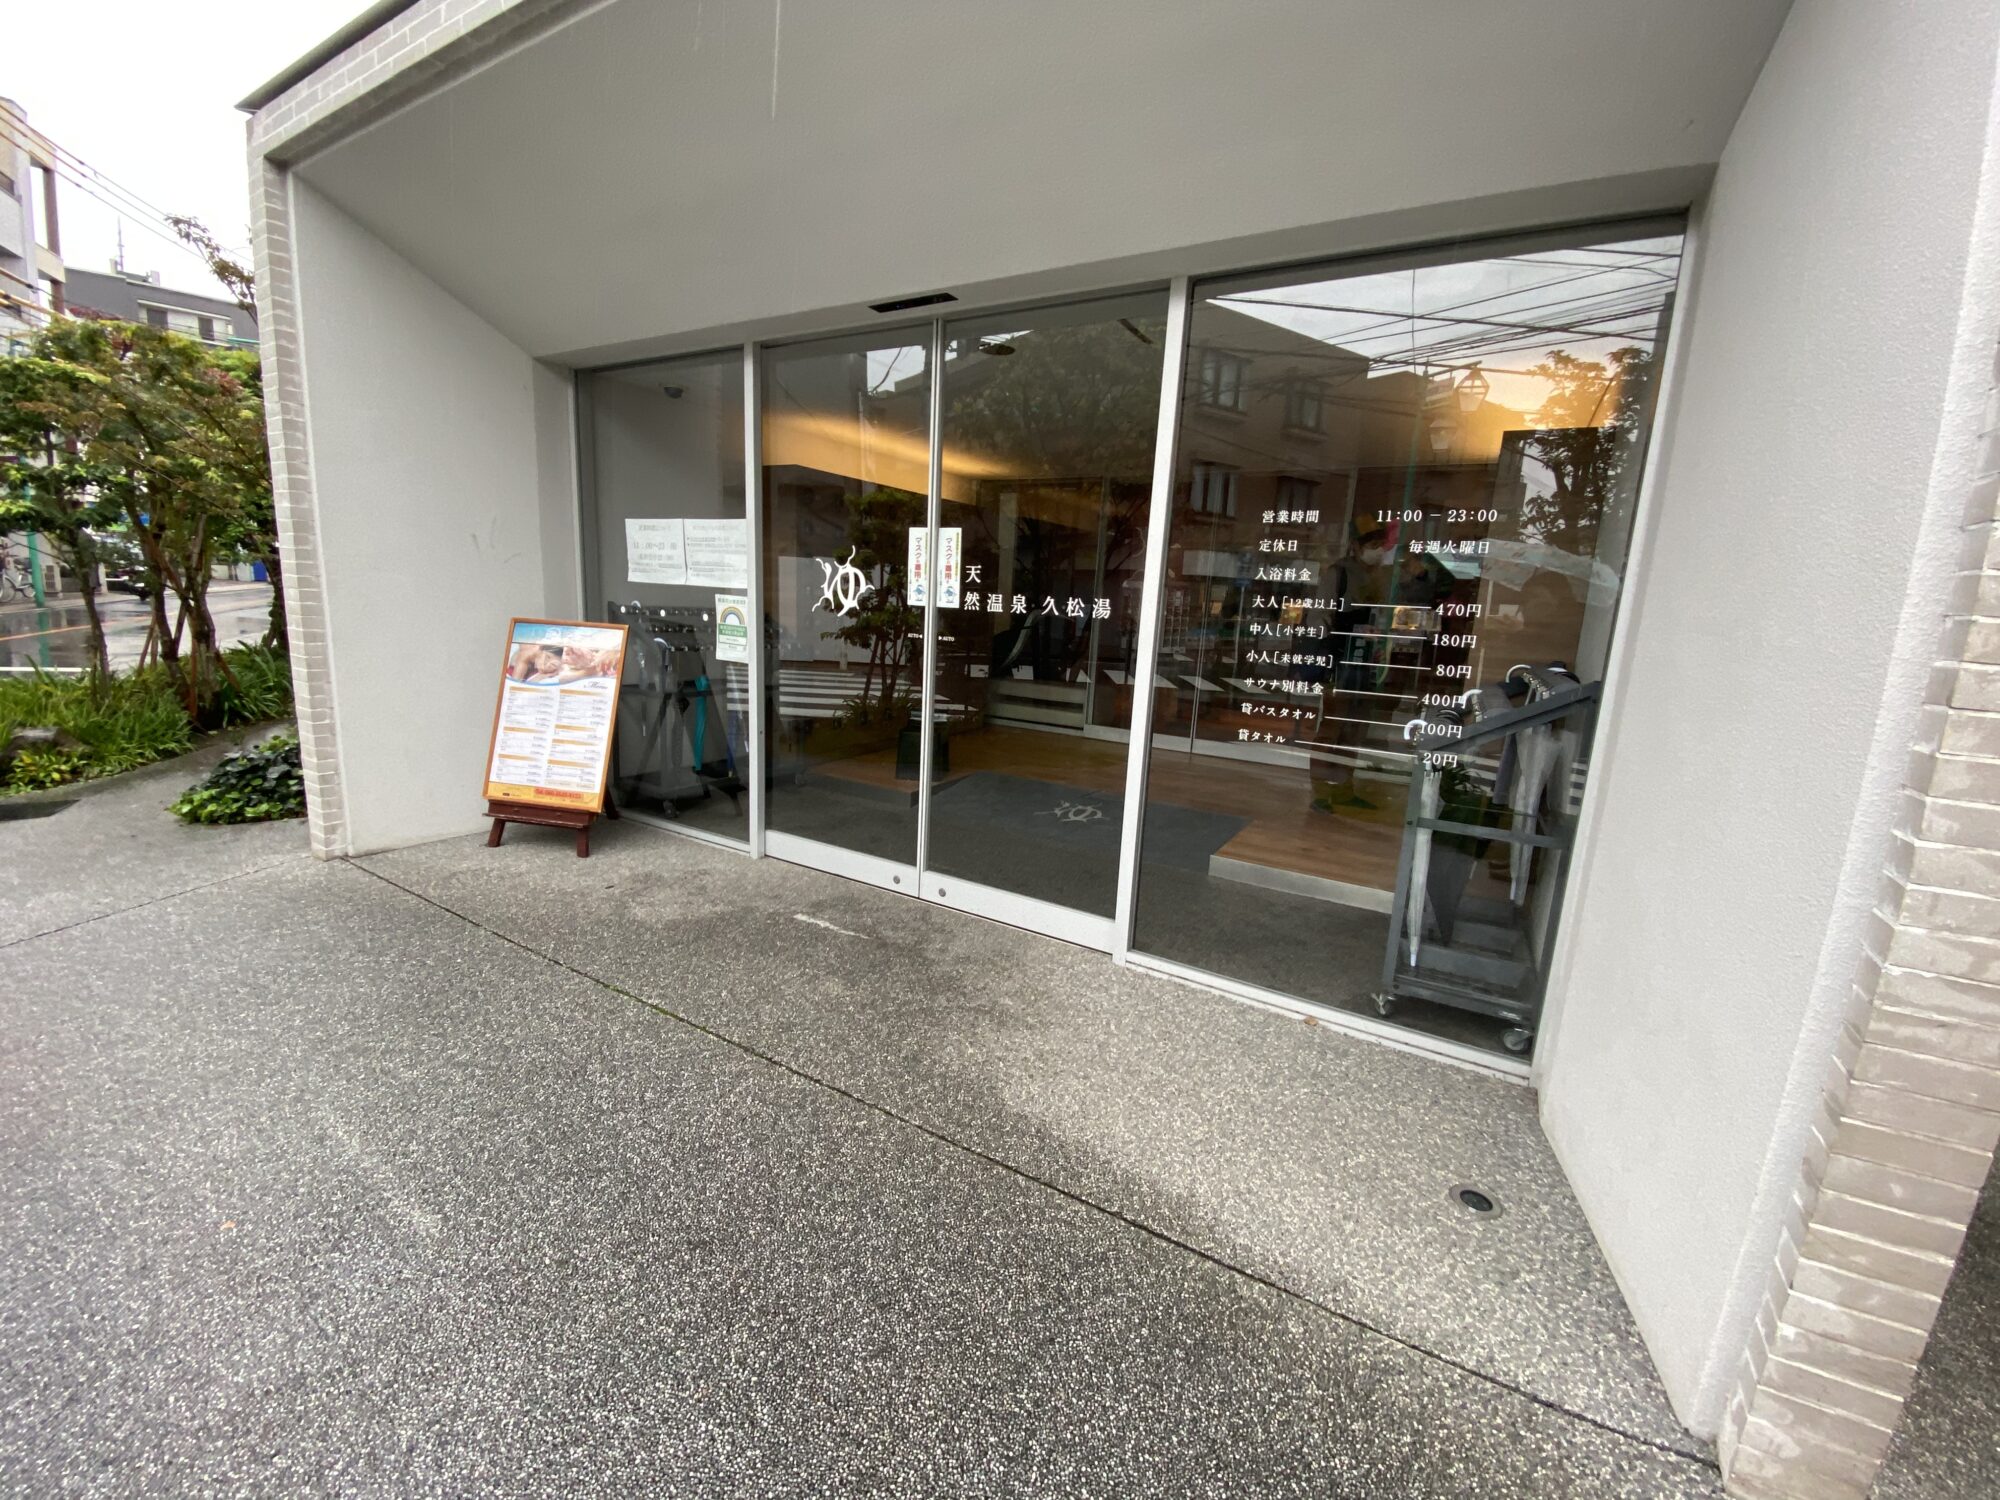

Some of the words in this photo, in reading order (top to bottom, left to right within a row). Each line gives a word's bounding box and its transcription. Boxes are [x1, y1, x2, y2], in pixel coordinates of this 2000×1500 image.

[1261, 509, 1320, 524] 営業時間
[1258, 539, 1298, 552] 定休日
[1408, 539, 1490, 555] 毎週火曜日
[1254, 567, 1312, 582] 入浴料金
[1435, 603, 1482, 618] 470円
[1432, 633, 1477, 649] 180円
[1435, 664, 1473, 679] 80円
[1243, 677, 1325, 696] サウナ別料金
[1421, 693, 1467, 709] 400円
[1240, 702, 1317, 720] 貸バスタオル
[1419, 723, 1463, 739] 100円
[1237, 728, 1287, 744] 貸タオル
[1422, 752, 1459, 768] 20円
